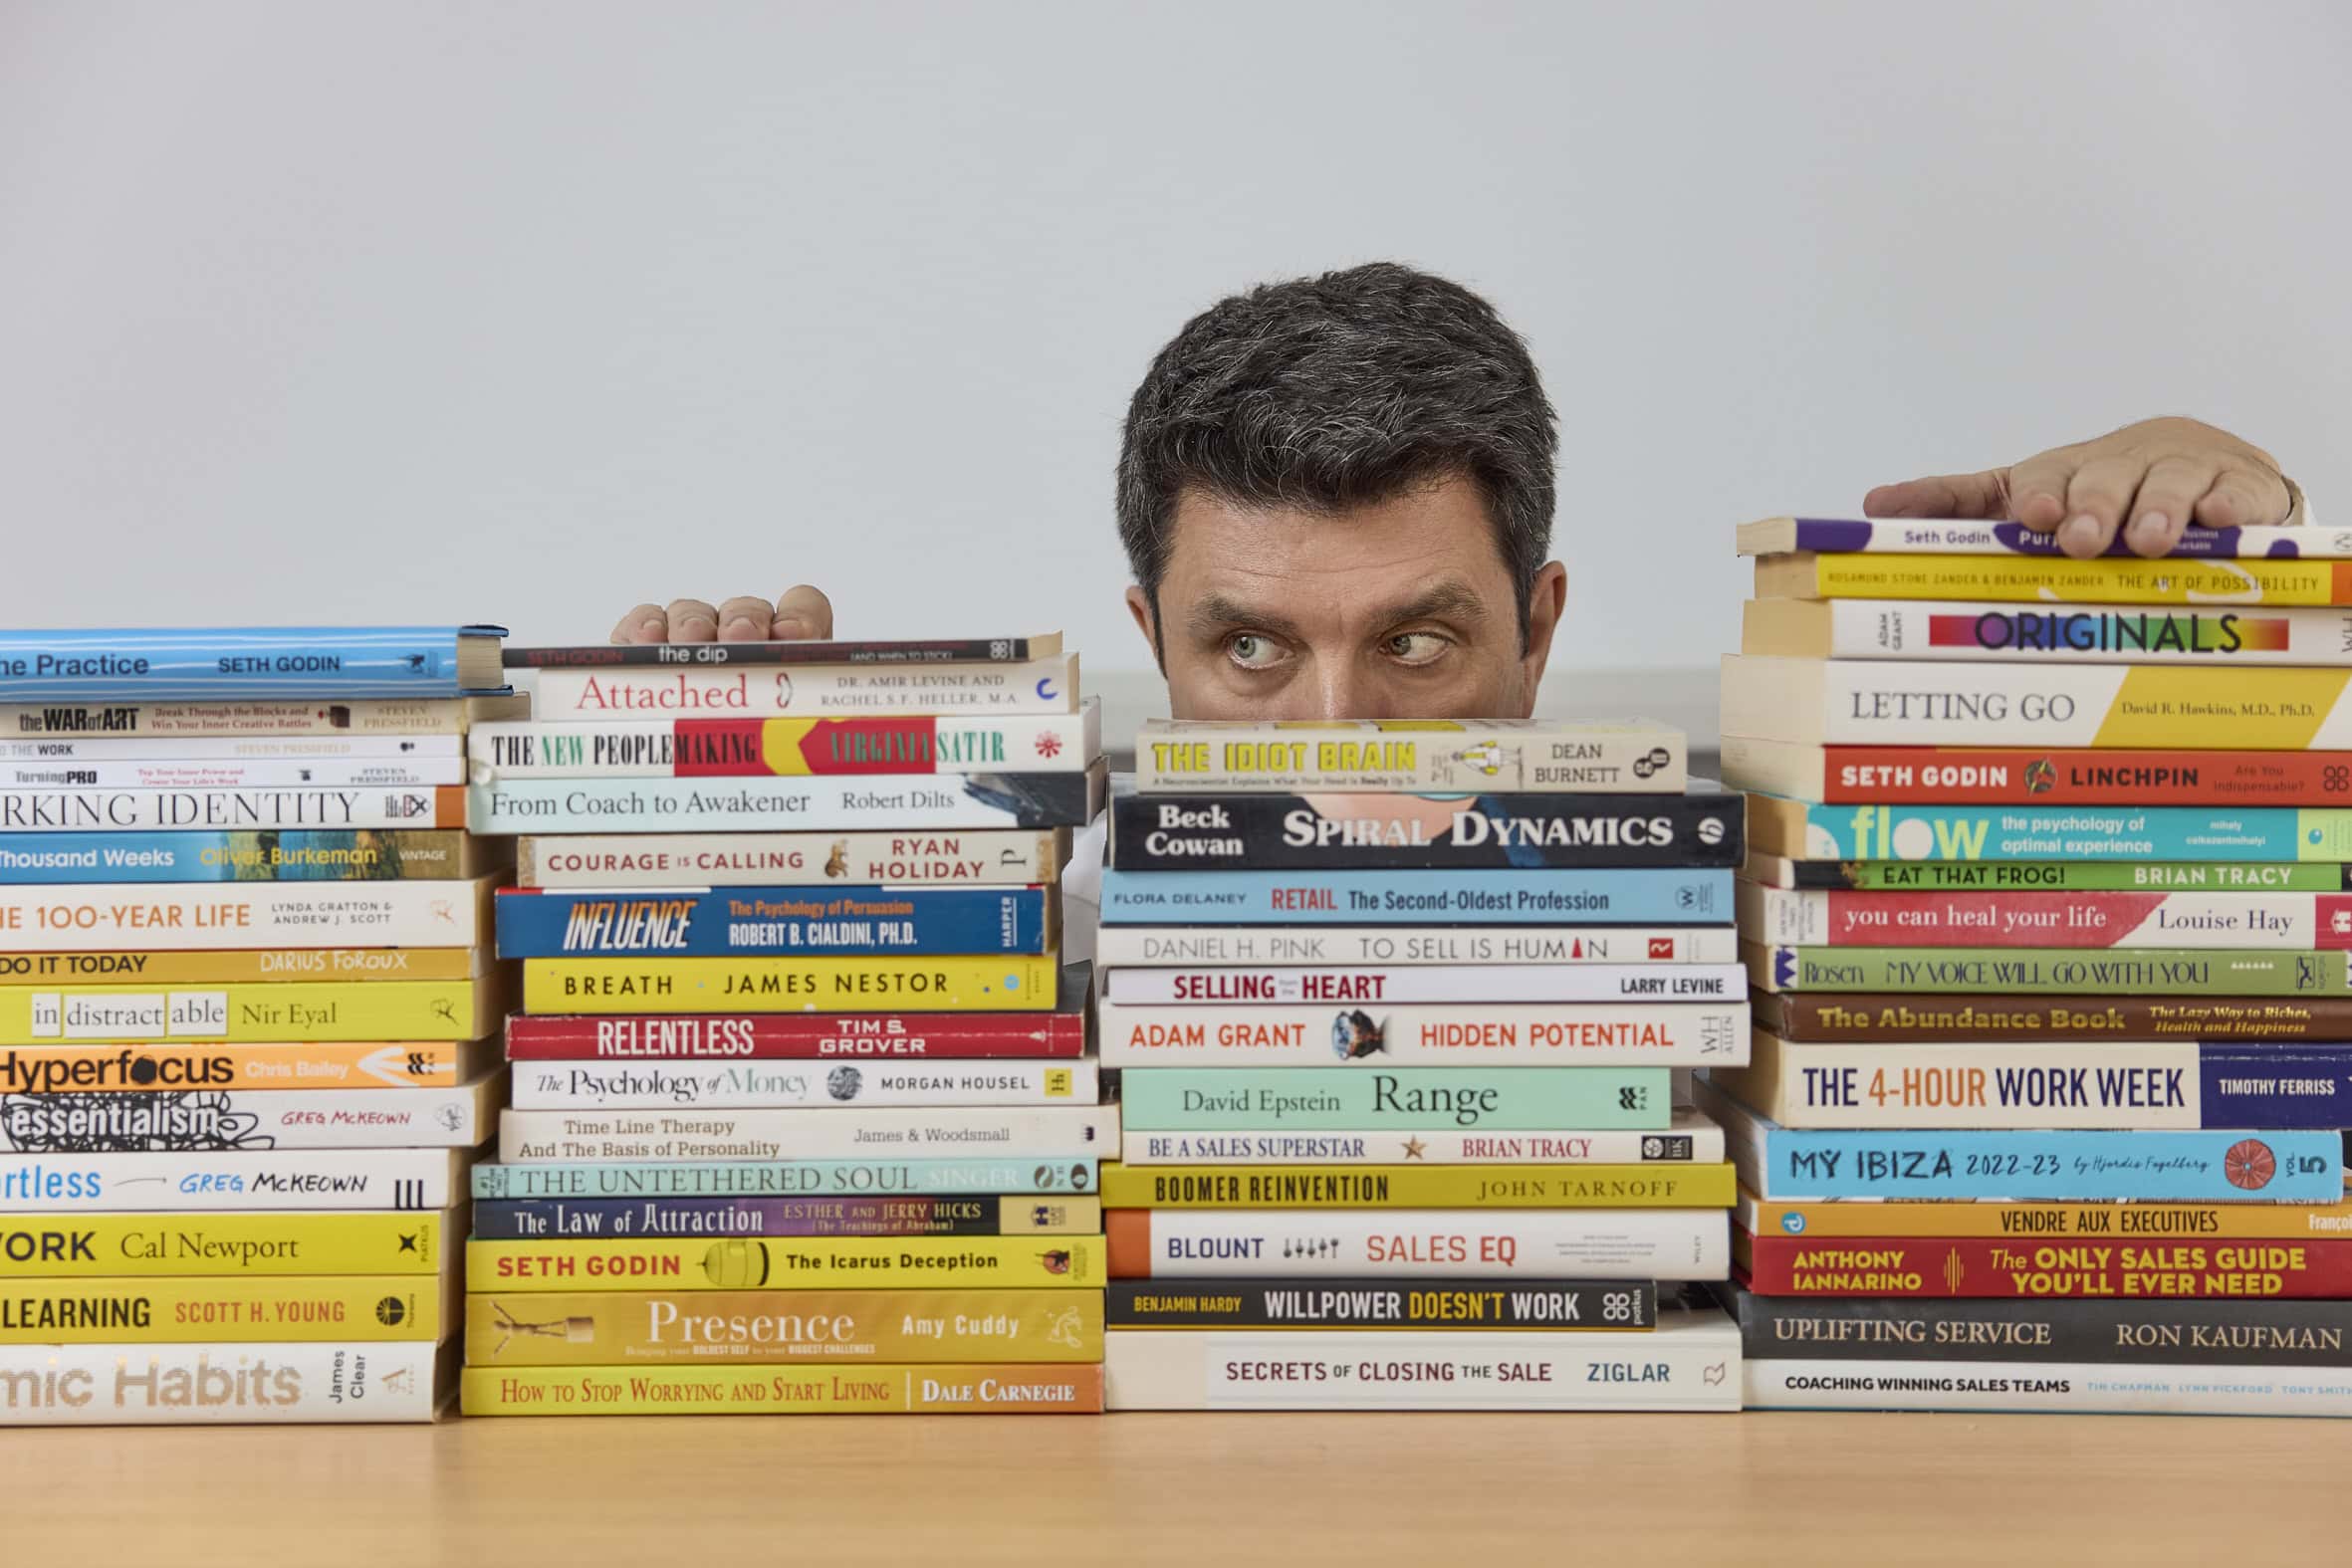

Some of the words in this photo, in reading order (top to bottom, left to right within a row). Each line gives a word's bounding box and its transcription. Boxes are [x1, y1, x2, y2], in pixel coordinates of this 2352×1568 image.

[1905, 531, 1940, 544] Seth
[1946, 531, 1991, 545] Godin
[2118, 574, 2143, 588] THE
[2151, 575, 2177, 589] ART
[2185, 575, 2203, 589] OF
[2212, 576, 2318, 589] POSSIBILITY
[1878, 613, 1888, 646] ADAM
[1892, 611, 1903, 650] GRANT
[1975, 611, 2241, 653] ORIGINALS
[37, 653, 148, 676] Practice
[218, 657, 270, 673] SETH
[277, 656, 341, 672] GODIN
[658, 647, 690, 662] the
[697, 646, 728, 664] dip
[837, 676, 862, 688] DR.
[869, 675, 907, 687] AMIR
[912, 674, 966, 687] LEVINE
[972, 673, 1005, 686] AND
[576, 673, 748, 709] Attached
[151, 721, 172, 730] Win
[177, 721, 198, 730] Your
[202, 720, 230, 730] Inner
[233, 719, 275, 730] Creative
[279, 718, 311, 729] Battles
[1152, 743, 1210, 772] THE
[1225, 743, 1306, 772] IDIOT
[1318, 742, 1416, 771] BRAIN
[1552, 744, 1602, 760] DEAN
[1534, 767, 1620, 783] BURNETT
[1841, 766, 1912, 786] SETH
[1923, 767, 2007, 787] GODIN
[2070, 769, 2199, 786] LINCHPIN
[2235, 766, 2256, 776] Are
[2262, 767, 2283, 776] You
[492, 793, 557, 815] From
[566, 791, 644, 814] Coach
[653, 793, 677, 814] to
[685, 790, 811, 813] Awakener
[842, 791, 902, 809] Robert
[910, 790, 955, 808] Dilts
[1159, 804, 1230, 828] Beck
[2210, 820, 2242, 833] mihaly
[892, 839, 959, 855] RYAN
[1146, 831, 1244, 855] Cowan
[2001, 838, 2060, 855] optimal
[2065, 838, 2153, 854] experience
[200, 848, 265, 866] Oliver
[270, 847, 377, 865] Burkeman
[399, 850, 447, 861] VINTAGE
[869, 861, 984, 878] HOLIDAY
[2135, 868, 2206, 884] BRIAN
[2216, 868, 2291, 885] TRACY
[1113, 894, 1165, 905] FLORA
[1172, 893, 1247, 904] DELANEY
[37, 905, 182, 929] 100-YEAR
[195, 904, 251, 927] LIFE
[563, 899, 698, 951] INFLUENCE
[1002, 897, 1014, 947] HARPER
[1844, 909, 1888, 932] you
[1897, 909, 1938, 926] can
[1947, 905, 1997, 926] heal
[2004, 908, 2060, 932] your
[2068, 906, 2107, 927] life
[2159, 908, 2238, 930] Louise
[2247, 910, 2293, 937] Hay
[565, 977, 672, 995] BREATH
[725, 975, 816, 994] JAMES
[835, 974, 947, 994] NESTOR
[1173, 976, 1276, 999] SELLING
[1302, 976, 1386, 999] HEART
[1621, 979, 1666, 994] LARRY
[1673, 979, 1724, 994] LEVINE
[242, 1003, 281, 1024] Nir
[290, 1002, 337, 1028] Eyal
[1817, 1008, 1869, 1027] The
[1878, 1008, 2040, 1028] Abundance
[2051, 1008, 2125, 1028] Book
[837, 1020, 880, 1033] TIM
[886, 1019, 906, 1033] S.
[1129, 1024, 1205, 1047] ADAM
[1218, 1023, 1305, 1046] GRANT
[1421, 1023, 1517, 1046] HIDDEN
[1529, 1023, 1674, 1045] POTENTIAL
[2156, 1021, 2200, 1032] Health
[2205, 1022, 2231, 1032] and
[2235, 1022, 2305, 1034] Happiness
[597, 1019, 754, 1055] RELENTLESS
[820, 1038, 926, 1052] GROVER
[0, 1050, 234, 1092] Hyperfocus
[245, 1061, 290, 1077] Chris
[296, 1061, 349, 1079] Bailey
[881, 1077, 954, 1090] MORGAN
[962, 1077, 1031, 1089] HOUSEL
[2220, 1078, 2275, 1095] TIMOTHY
[2279, 1079, 2335, 1095] FERRISS
[1183, 1090, 1250, 1111] David
[1260, 1090, 1340, 1117] Epstein
[1372, 1074, 1499, 1125] Range
[11, 1101, 219, 1137] essentialism
[853, 1129, 900, 1143] James
[908, 1129, 920, 1142] &
[925, 1128, 1010, 1142] Woodsmall
[1149, 1139, 1172, 1156] BE
[1179, 1139, 1191, 1156] A
[1196, 1139, 1252, 1156] SALES
[1258, 1139, 1365, 1157] SUPERSTAR
[1462, 1139, 1522, 1157] BRIAN
[1527, 1139, 1592, 1157] TRACY
[520, 1169, 586, 1194] THE
[597, 1168, 821, 1193] UNTETHERED
[832, 1167, 918, 1190] SOUL
[927, 1169, 1019, 1187] SINGER
[1155, 1176, 1240, 1202] BOOMER
[1250, 1176, 1388, 1201] REINVENTION
[1477, 1182, 1545, 1201] JOHN
[1558, 1182, 1677, 1196] TARNOFF
[784, 1205, 844, 1219] ESTHER
[851, 1207, 876, 1218] AND
[883, 1204, 928, 1219] JERRY
[933, 1203, 982, 1218] HICKS
[2001, 1211, 2066, 1232] VENDRE
[2077, 1211, 2110, 1232] AUX
[2121, 1211, 2219, 1232] EXECUTIVES
[120, 1232, 166, 1258] Cal
[177, 1232, 299, 1266] Newport
[1168, 1238, 1264, 1258] BLOUNT
[497, 1257, 575, 1276] SETH
[587, 1256, 680, 1275] GODIN
[787, 1254, 822, 1268] The
[830, 1253, 891, 1268] Icarus
[899, 1253, 999, 1270] Deception
[1793, 1251, 1904, 1268] ANTHONY
[1793, 1273, 1922, 1290] IANNARINO
[3, 1298, 150, 1328] LEARNING
[175, 1302, 242, 1323] SCOTT
[250, 1302, 269, 1322] H.
[276, 1301, 346, 1322] YOUNG
[1134, 1296, 1196, 1312] BENJAMIN
[1200, 1297, 1242, 1311] HARDY
[1634, 1289, 1643, 1325] piatkus
[645, 1301, 854, 1343] Presence
[1774, 1318, 1926, 1342] UPLIFTING
[1935, 1320, 2051, 1345] SERVICE
[329, 1351, 345, 1404] James
[351, 1355, 364, 1399] Clear
[1586, 1363, 1670, 1382] ZIGLAR
[1785, 1376, 1874, 1391] COACHING
[1878, 1377, 1953, 1392] WINNING
[1957, 1379, 2008, 1393] SALES
[2012, 1379, 2069, 1394] TEAMS
